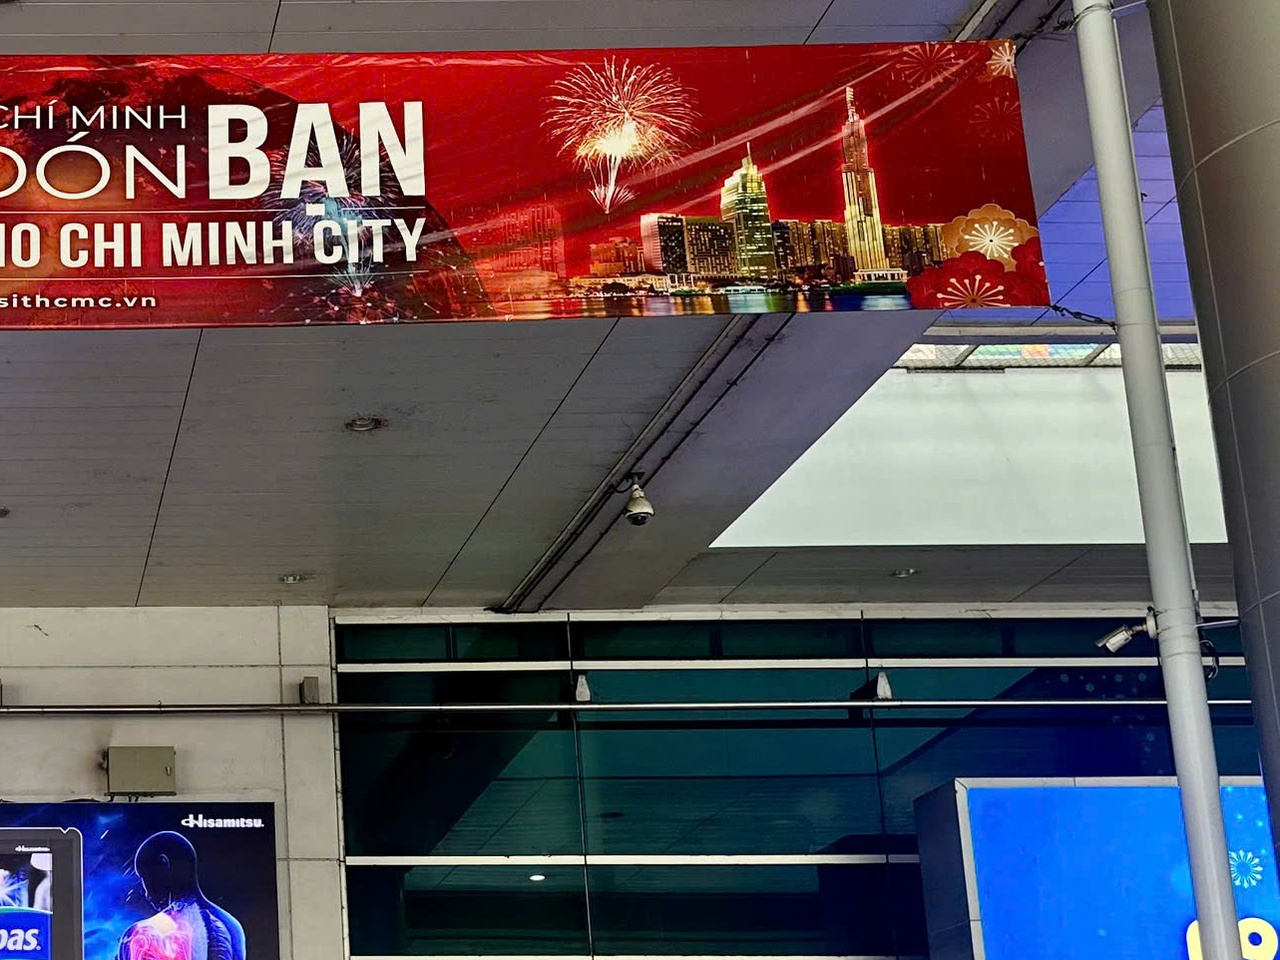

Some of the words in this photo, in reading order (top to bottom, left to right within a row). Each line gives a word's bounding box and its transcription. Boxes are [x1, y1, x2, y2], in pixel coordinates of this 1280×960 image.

[72, 105, 186, 130] MINH
[207, 101, 426, 216] BẠN
[60, 222, 141, 268] CHI
[162, 220, 294, 267] MINH
[314, 217, 426, 265] CITY
